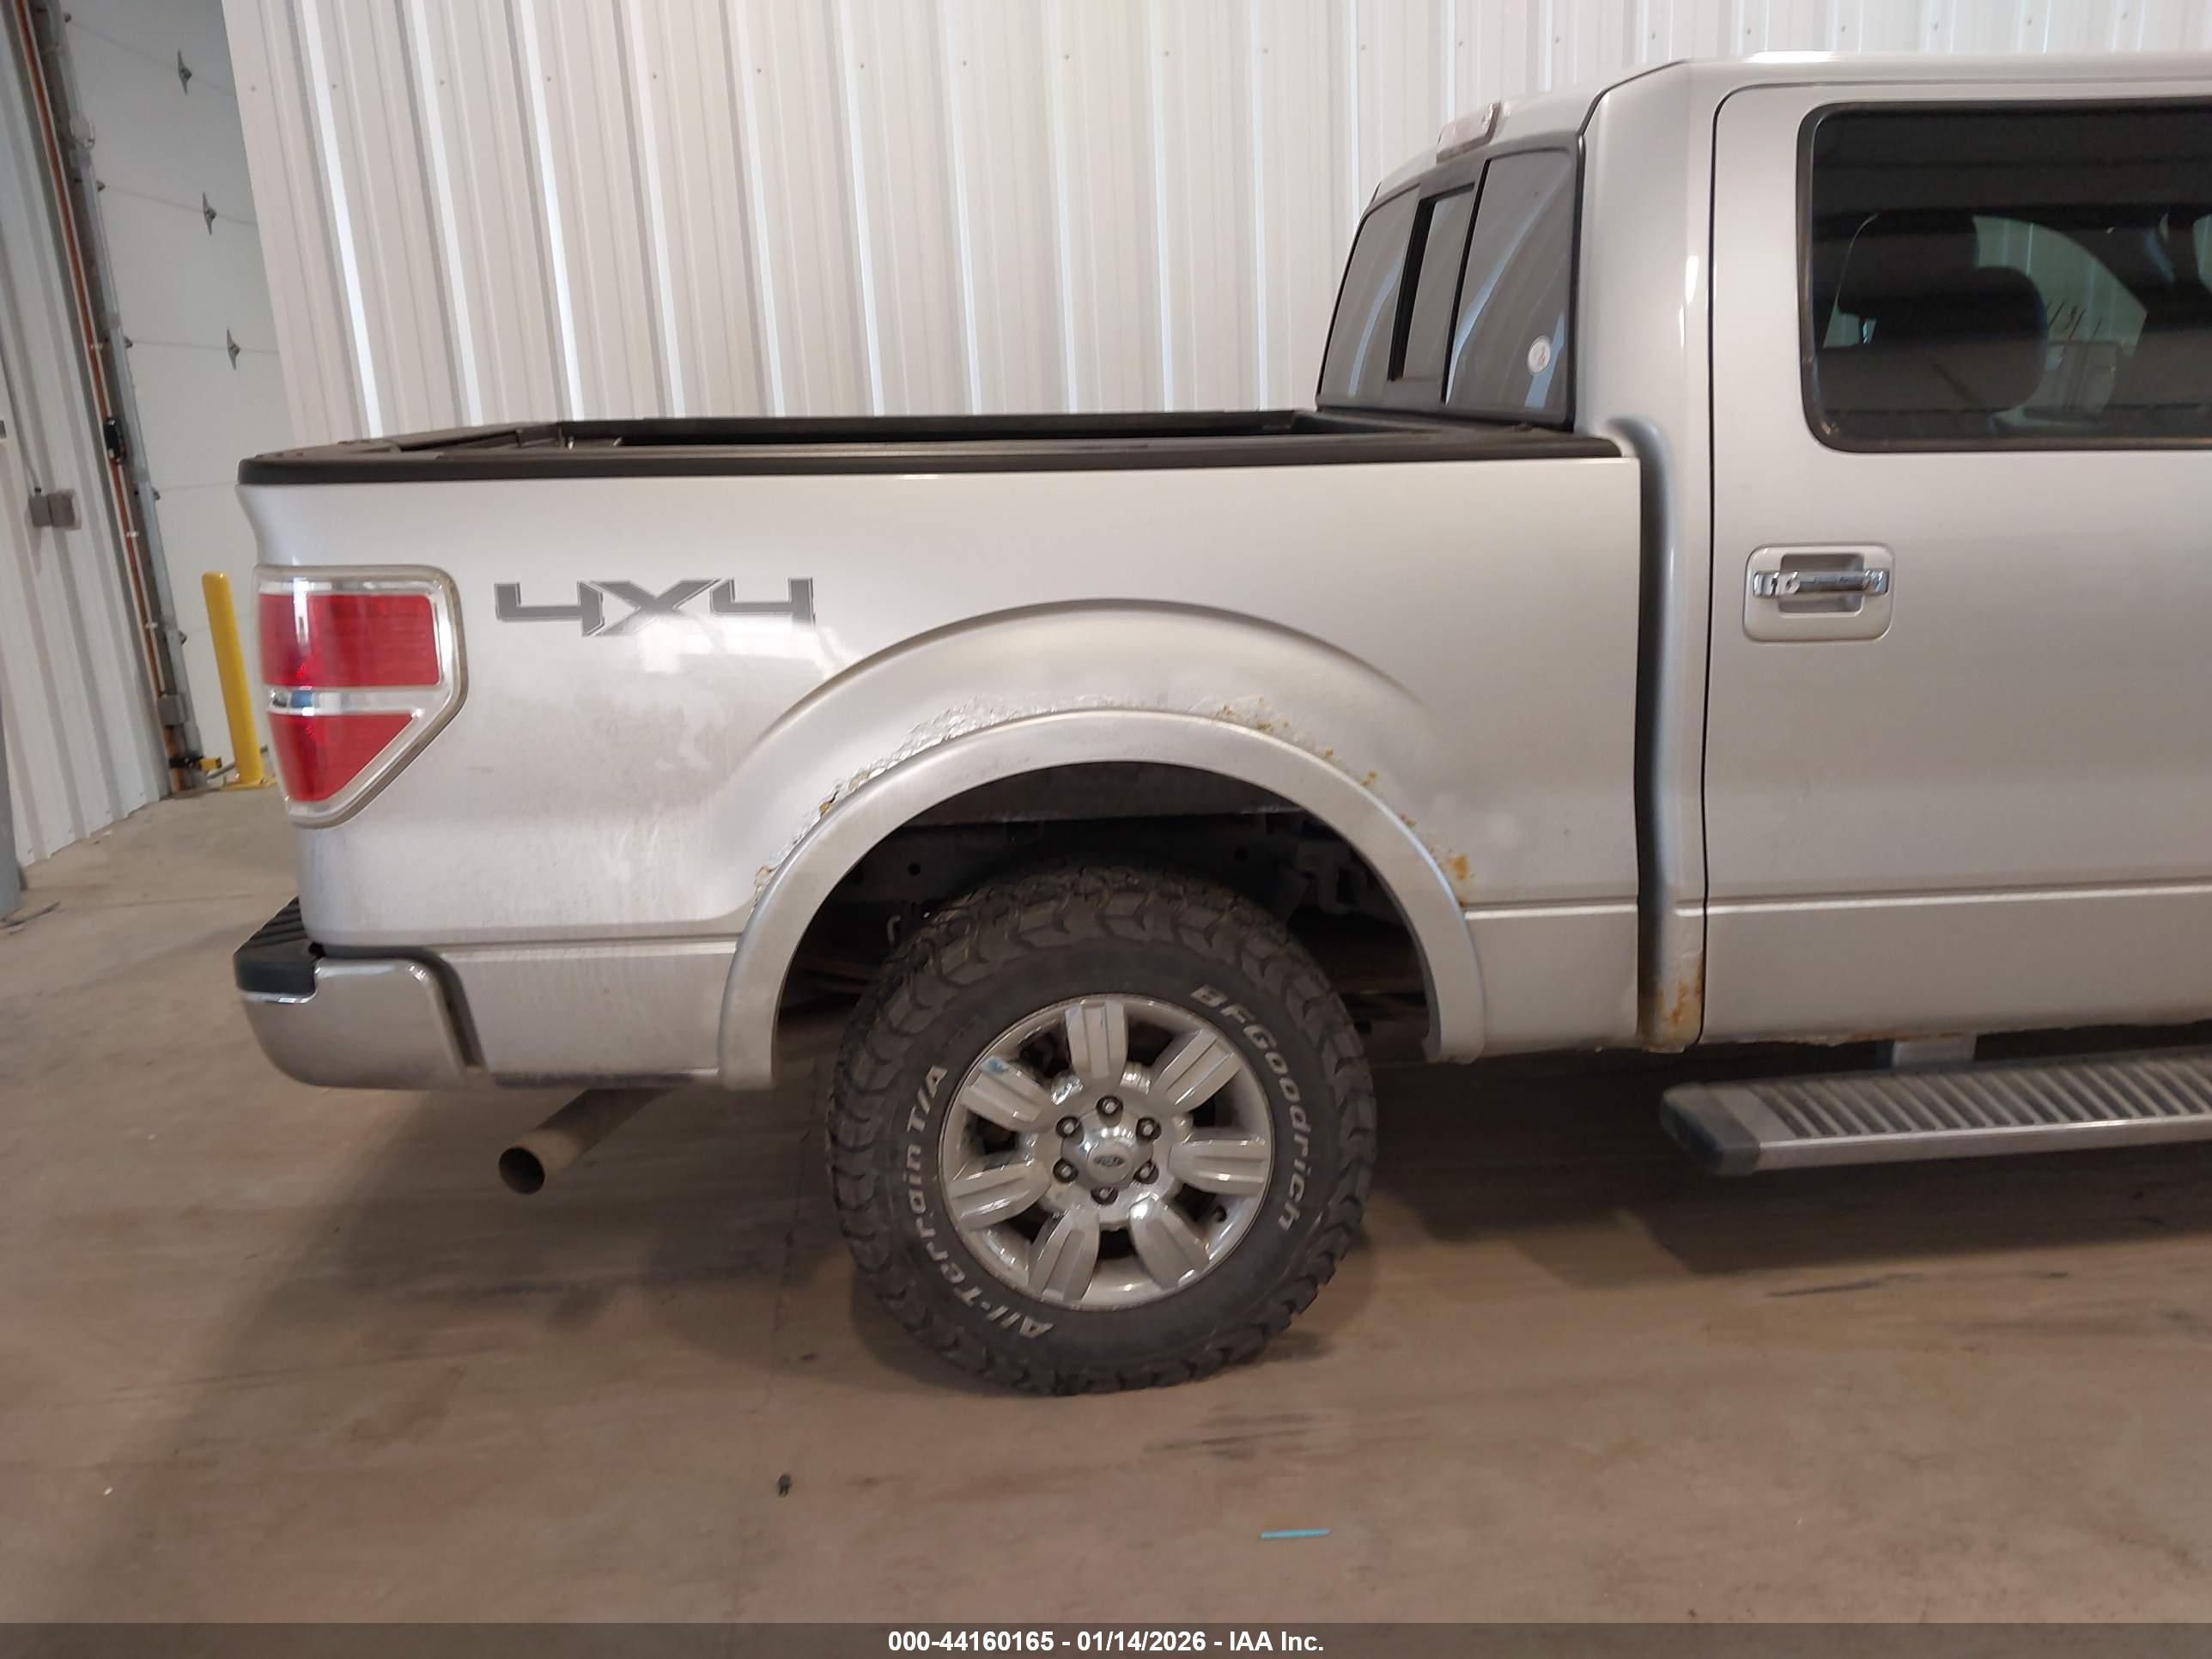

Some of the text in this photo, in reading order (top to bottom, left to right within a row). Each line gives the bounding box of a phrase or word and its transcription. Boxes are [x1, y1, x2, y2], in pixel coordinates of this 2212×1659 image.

[903, 1066, 1054, 1339] All-Terrain T/A
[1190, 985, 1312, 1231] BFGoodrich
